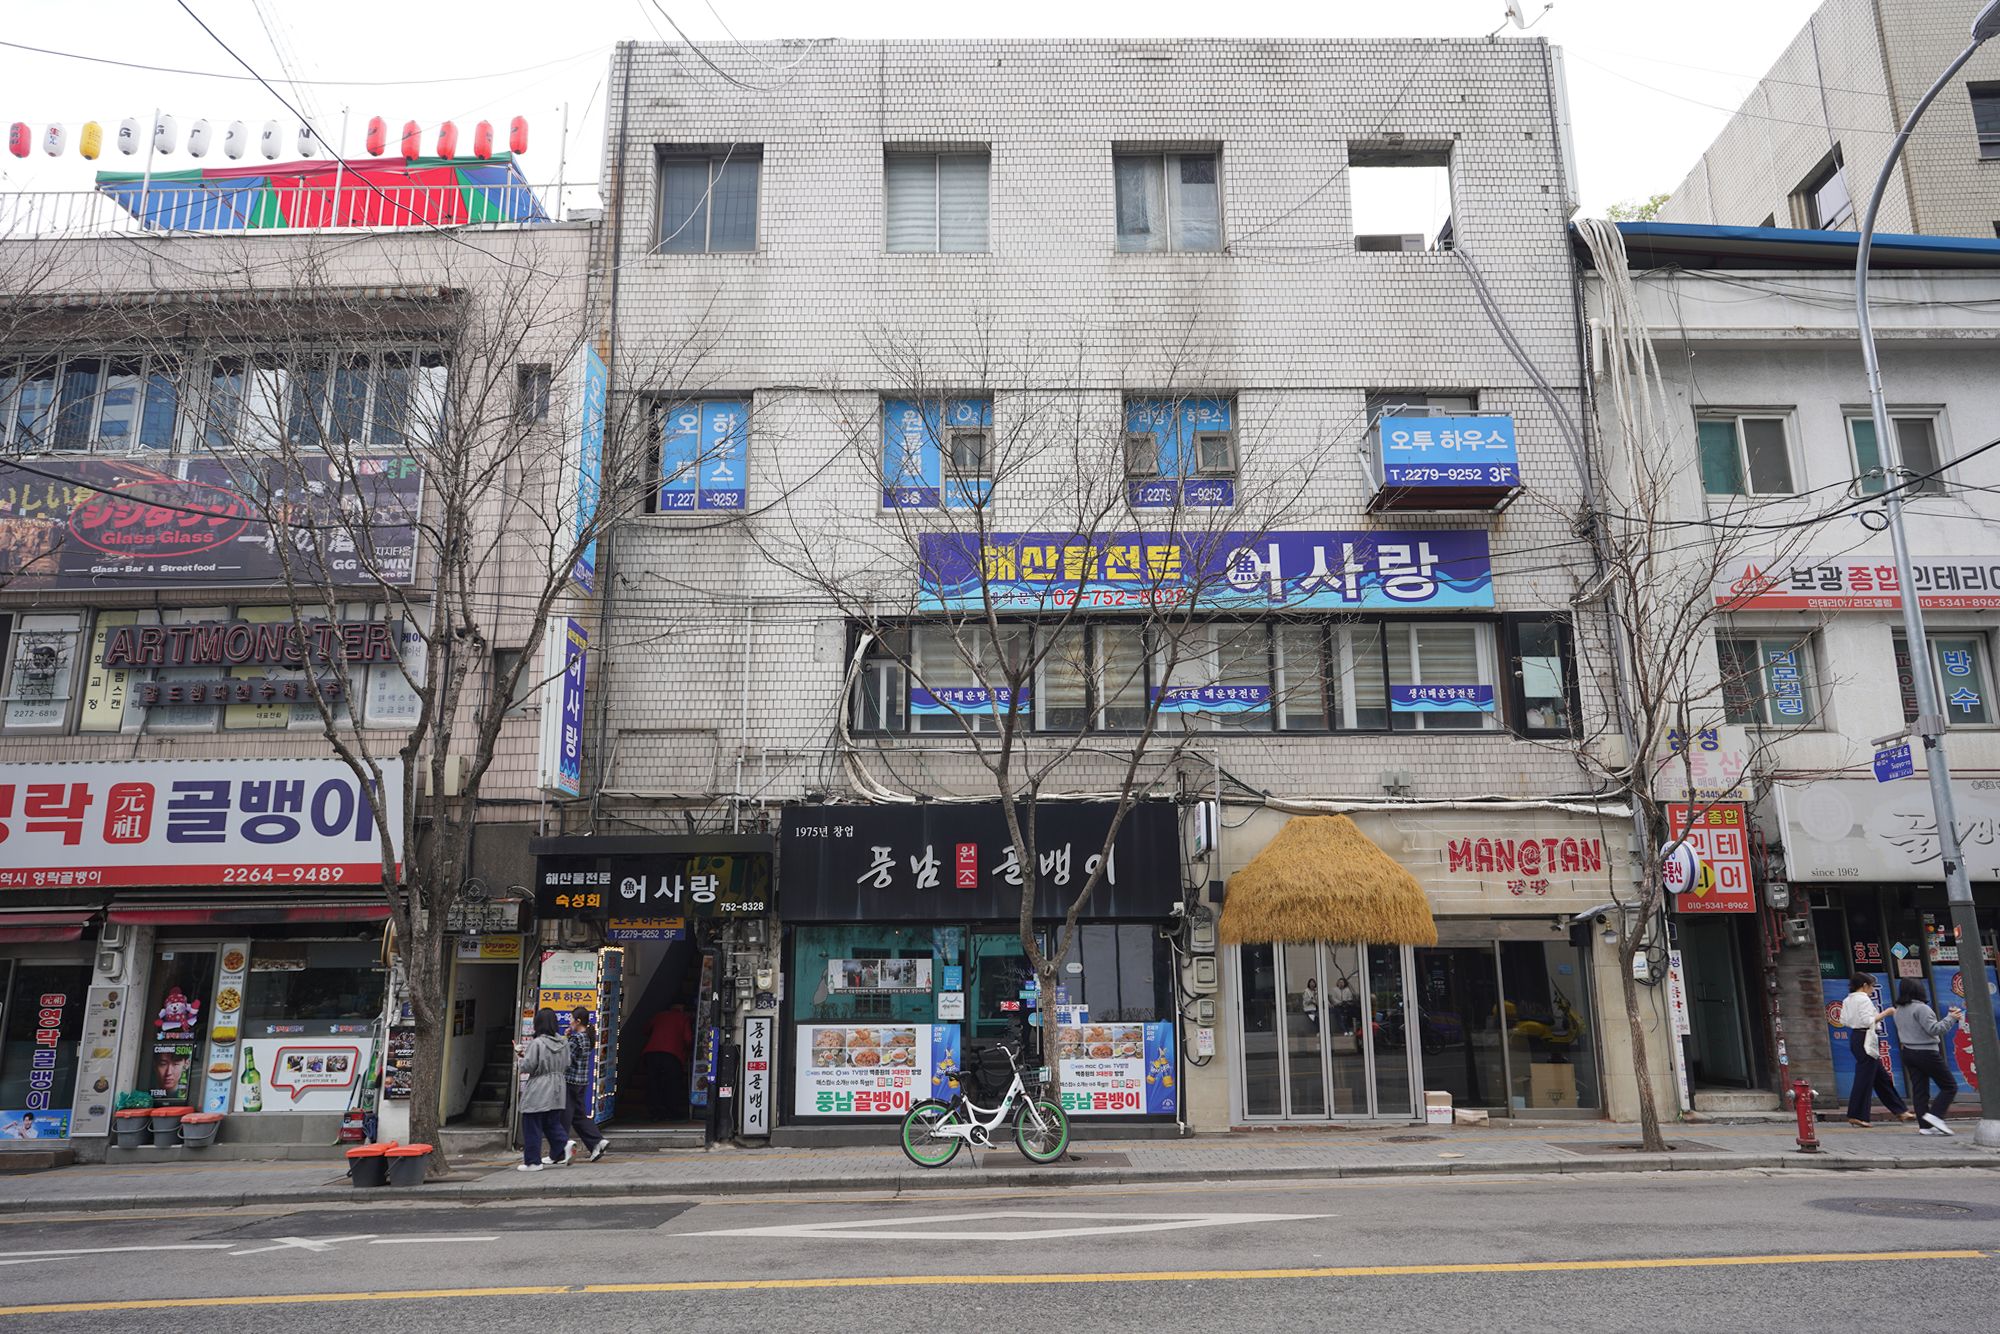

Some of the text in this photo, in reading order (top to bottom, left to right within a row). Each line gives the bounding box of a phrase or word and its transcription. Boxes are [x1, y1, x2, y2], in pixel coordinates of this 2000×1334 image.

[1390, 429, 1508, 452] 오투 하우스
[1390, 466, 1511, 482] T.2279-9252 3F
[101, 530, 214, 545] Glass Glass
[332, 558, 357, 570] GG
[980, 545, 1181, 580] 해산물전문
[1226, 542, 1439, 600] 어사랑
[1790, 566, 1843, 591] 보광
[1847, 565, 1900, 592] 종합
[105, 624, 391, 664] ARTMONSTER
[1943, 650, 1981, 713] 방수
[1204, 688, 1260, 700] 매운탕전문
[1408, 687, 1476, 700] 생선매운탕전문
[111, 786, 147, 840] 元祖
[165, 777, 383, 845] 골뱅이
[1707, 810, 1739, 825] 종합
[794, 825, 854, 838] 1975년 창업
[857, 844, 942, 889] 풍남
[959, 845, 976, 886] 원조
[1837, 867, 1859, 877] 1962
[33, 869, 102, 886] 영락골뱅이
[223, 867, 344, 883] 2264-9489
[545, 872, 612, 886] 해산물전문
[619, 874, 721, 904] 어사랑
[555, 892, 602, 909] 숙성회
[720, 901, 765, 912] 752-8328
[1687, 902, 1749, 910] 010-5341-8962
[613, 929, 677, 939] T.2279-9252 3F
[541, 991, 593, 1003] 오투 하우스
[25, 1008, 63, 1111] 영락골뱅이
[748, 1073, 764, 1128] 골뱅이
[815, 1090, 910, 1112] 풍남골뱅이
